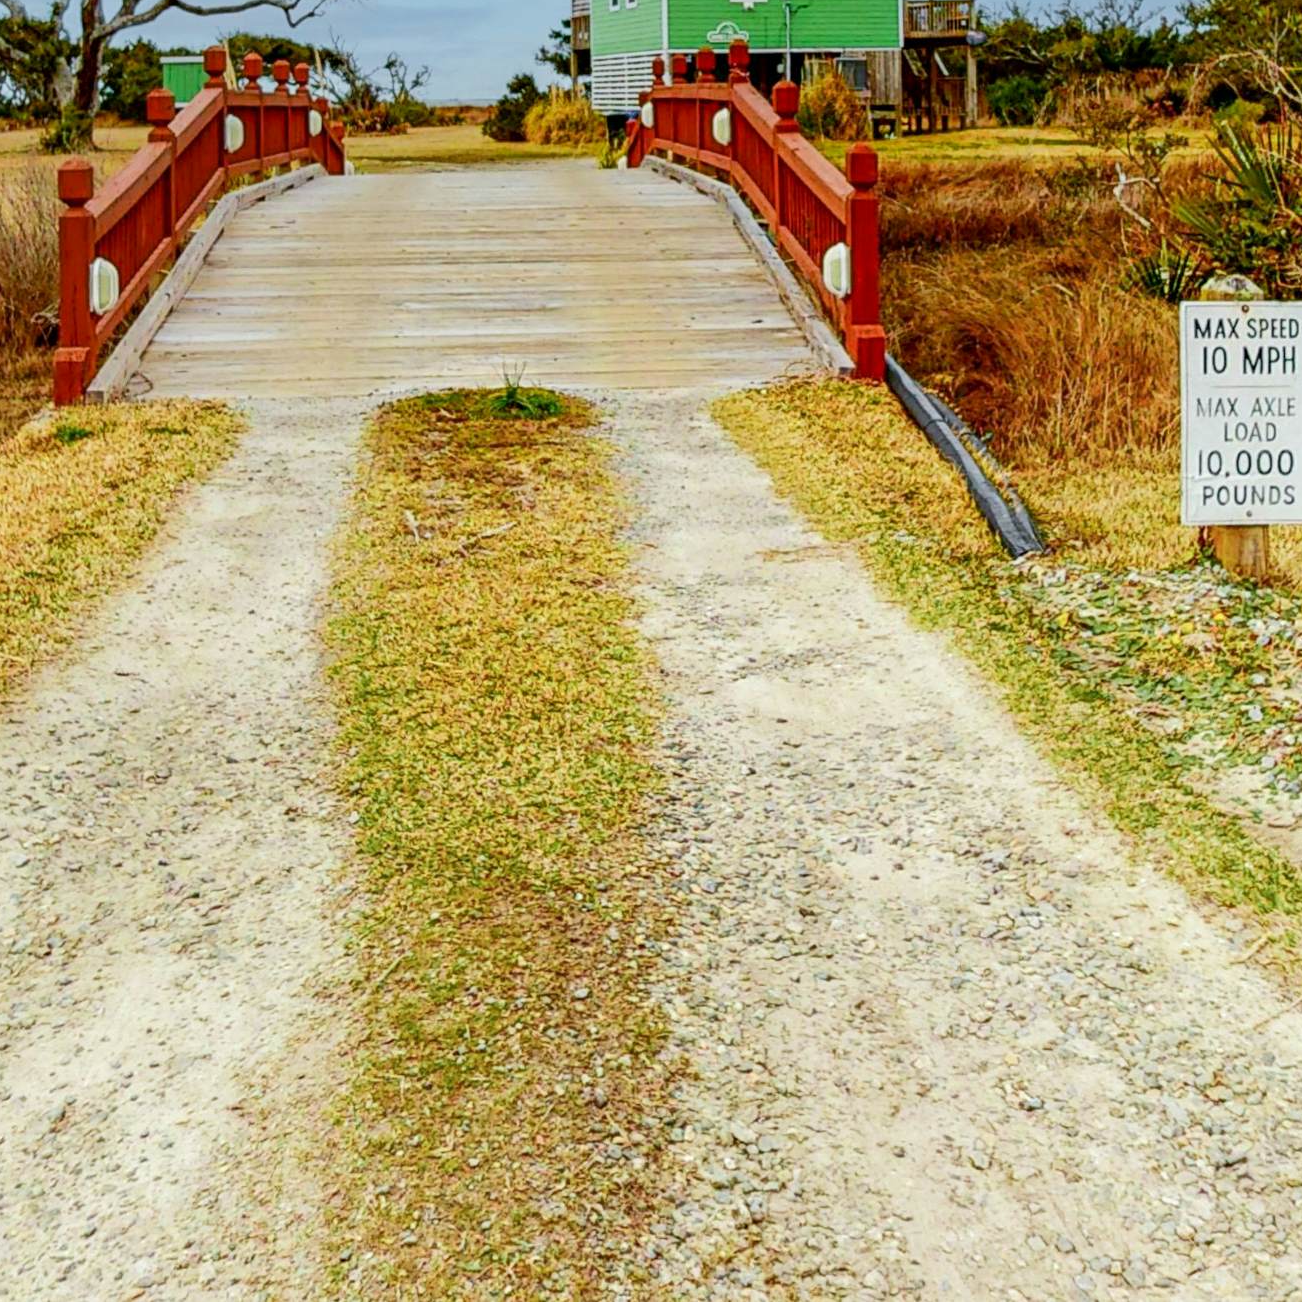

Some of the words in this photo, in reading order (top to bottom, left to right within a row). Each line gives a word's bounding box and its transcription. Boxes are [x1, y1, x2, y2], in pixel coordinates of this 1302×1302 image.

[1193, 318, 1240, 339] MAX
[1247, 318, 1300, 339] SPEED
[1202, 346, 1227, 375] 10
[1242, 346, 1296, 375] MPH
[1196, 397, 1239, 418] MAX
[1250, 397, 1296, 417] AXLE
[1224, 422, 1277, 442] LOAD
[1198, 450, 1294, 478] 10,000
[1202, 485, 1296, 506] POUNDS
